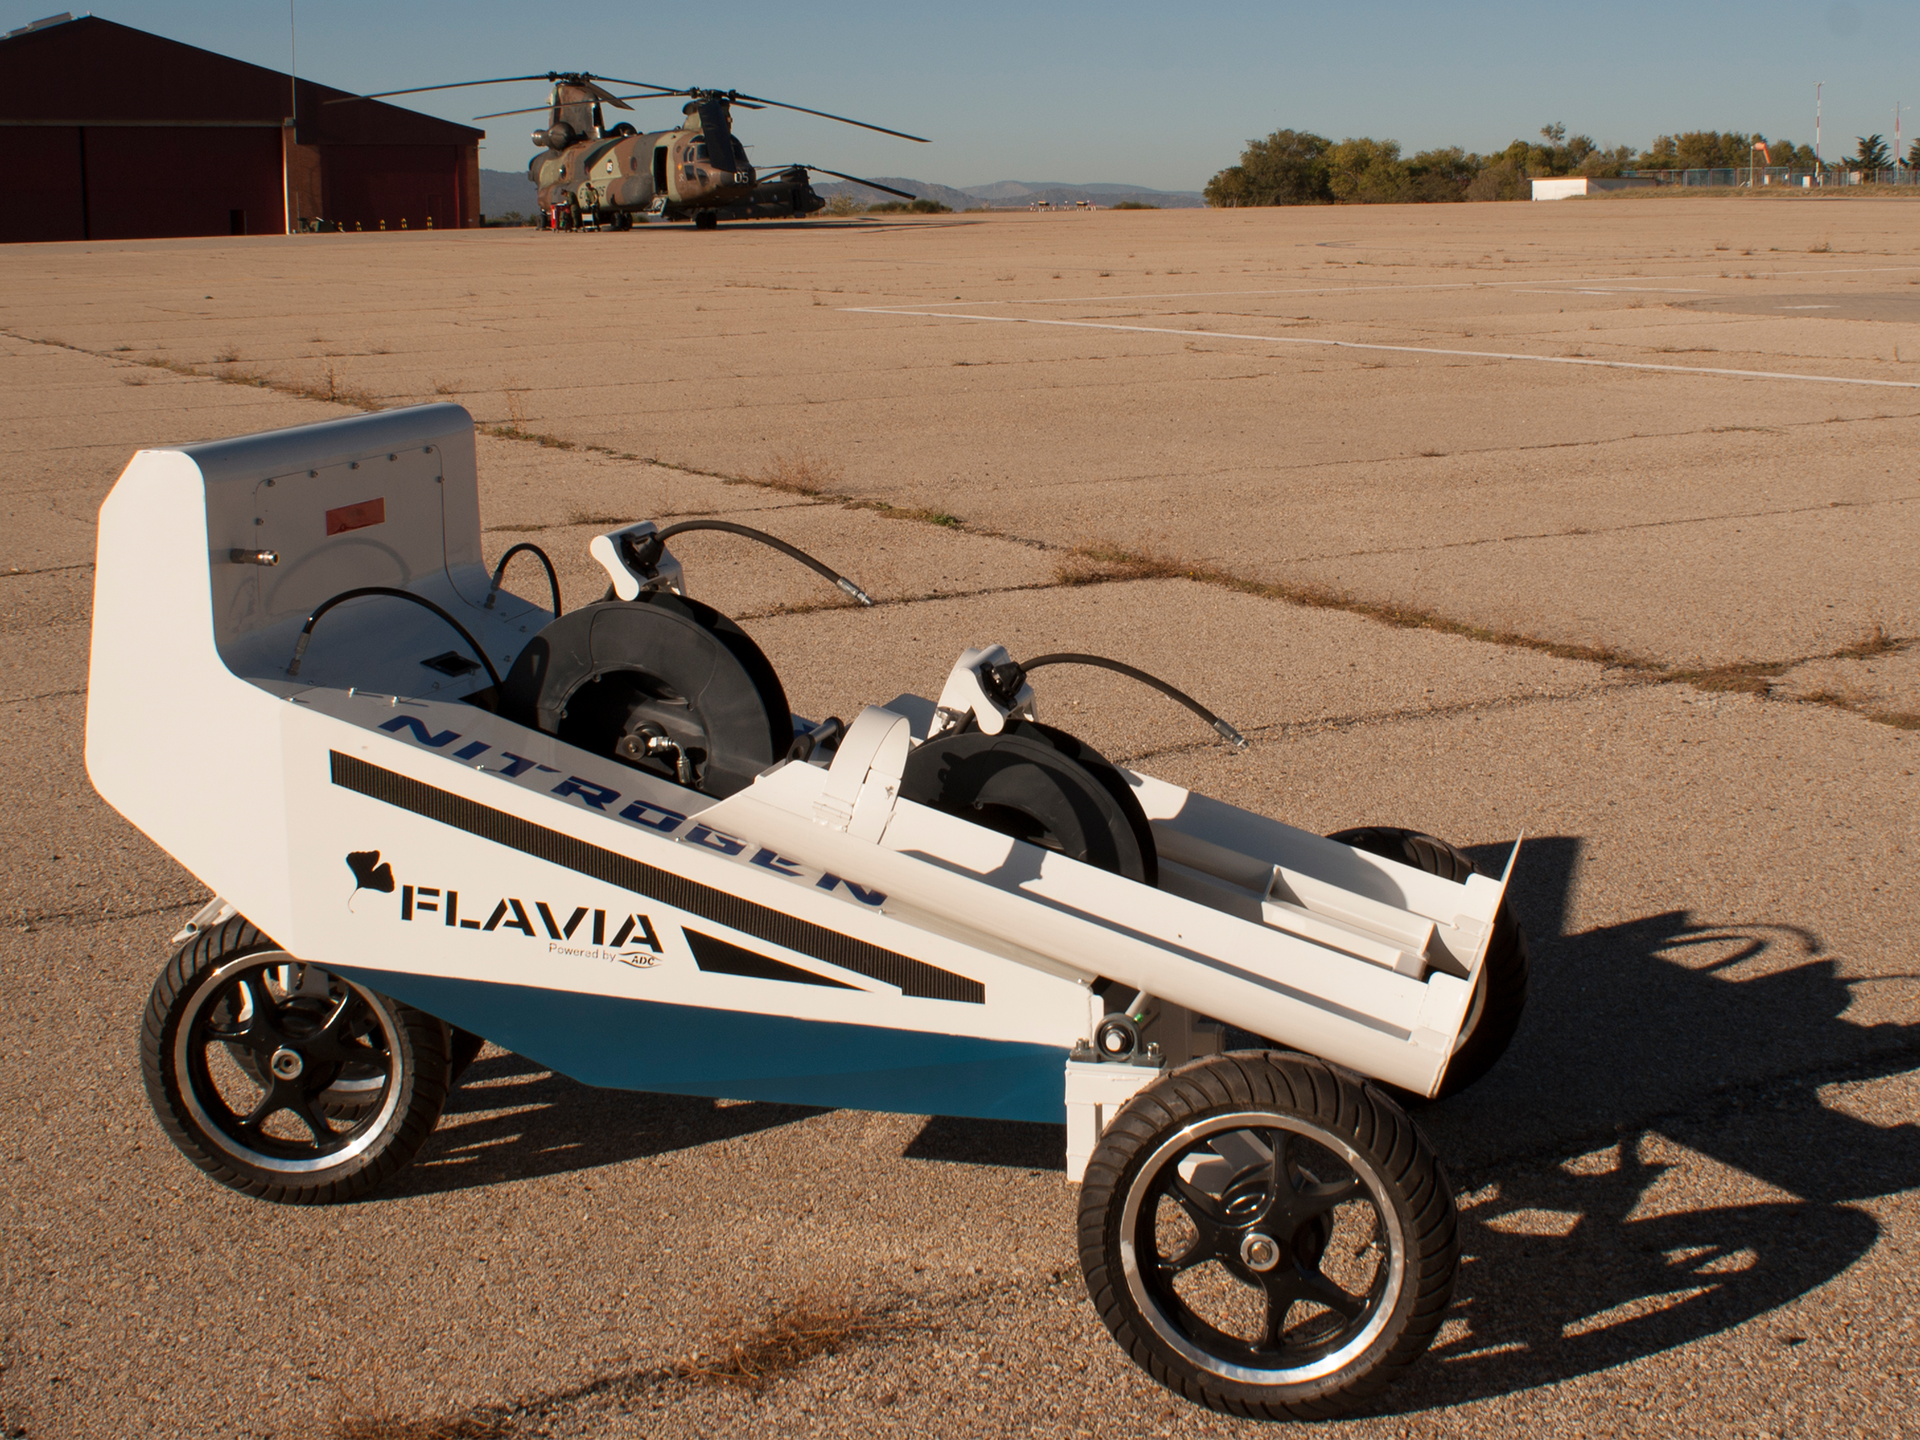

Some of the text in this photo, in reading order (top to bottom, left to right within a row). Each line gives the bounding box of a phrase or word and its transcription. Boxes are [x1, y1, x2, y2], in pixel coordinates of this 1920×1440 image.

[733, 171, 749, 184] 05
[378, 715, 888, 906] NITROGEN
[401, 884, 664, 953] FLAVIA
[548, 942, 655, 967] Powered by ADC
